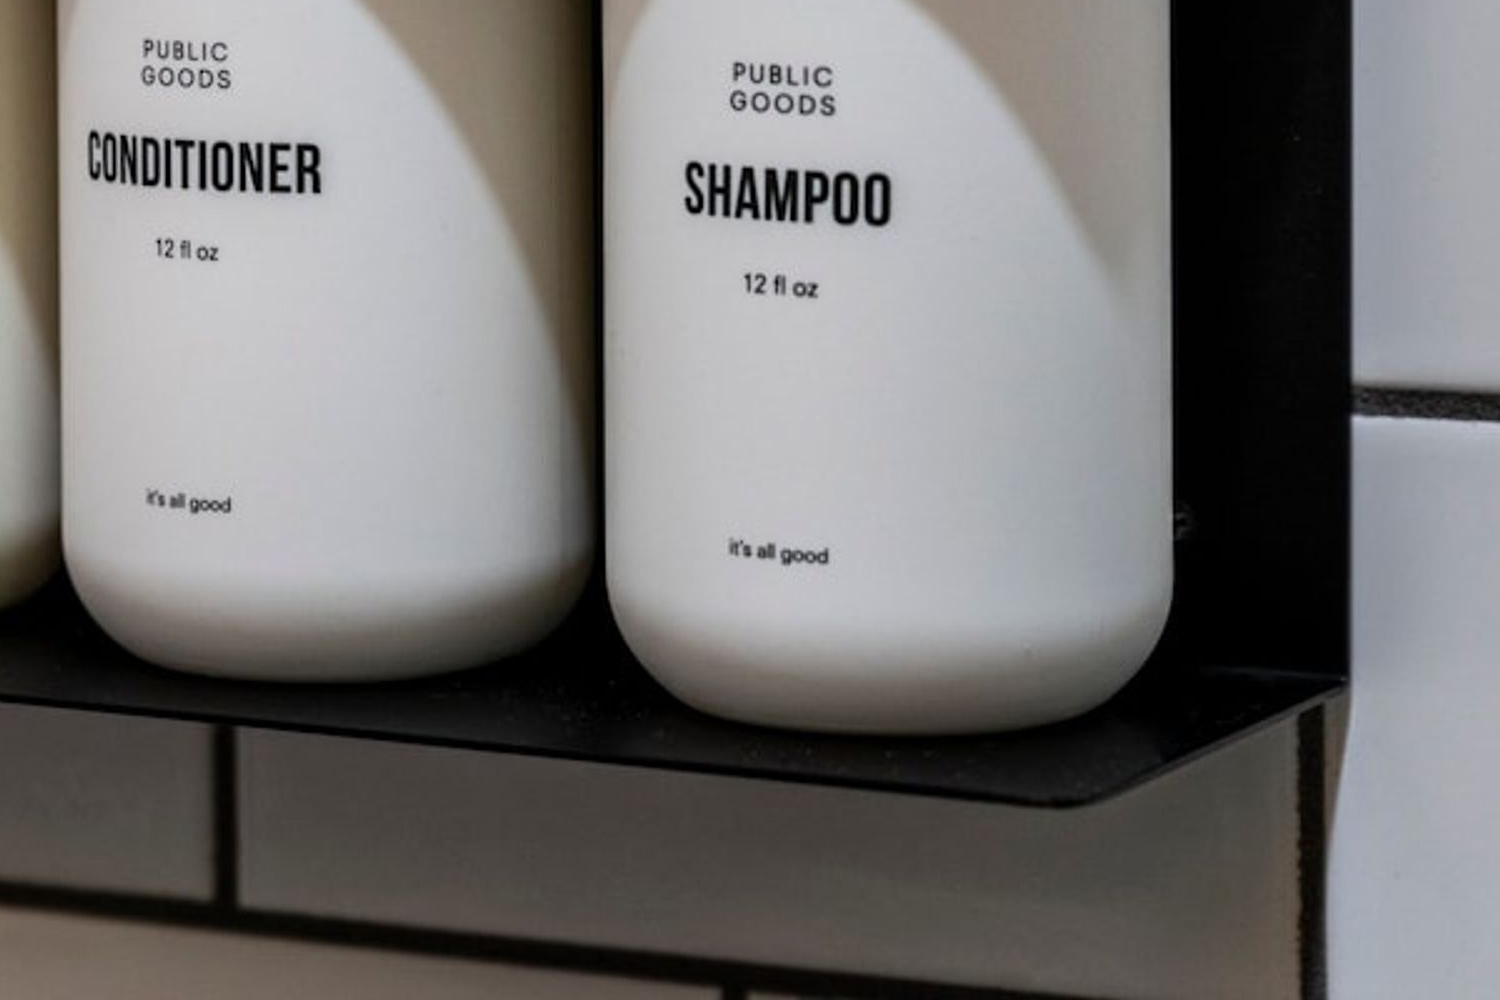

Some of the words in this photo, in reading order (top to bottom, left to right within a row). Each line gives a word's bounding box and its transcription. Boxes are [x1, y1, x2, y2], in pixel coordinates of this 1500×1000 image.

[143, 39, 228, 62] PUBLIC
[141, 66, 232, 89] GOODS
[733, 62, 833, 88] PUBLIC
[730, 91, 837, 117] GOODS
[88, 130, 321, 194] CONDITIONER
[684, 161, 891, 227] SHAMPOO
[156, 238, 174, 259] 12
[180, 240, 191, 259] fl
[196, 246, 218, 261] oz
[744, 273, 767, 295] 12
[773, 275, 786, 295] fl
[792, 282, 819, 298] oz
[169, 493, 186, 509] all
[189, 497, 231, 514] good
[756, 543, 776, 560] all
[780, 548, 829, 566] good
